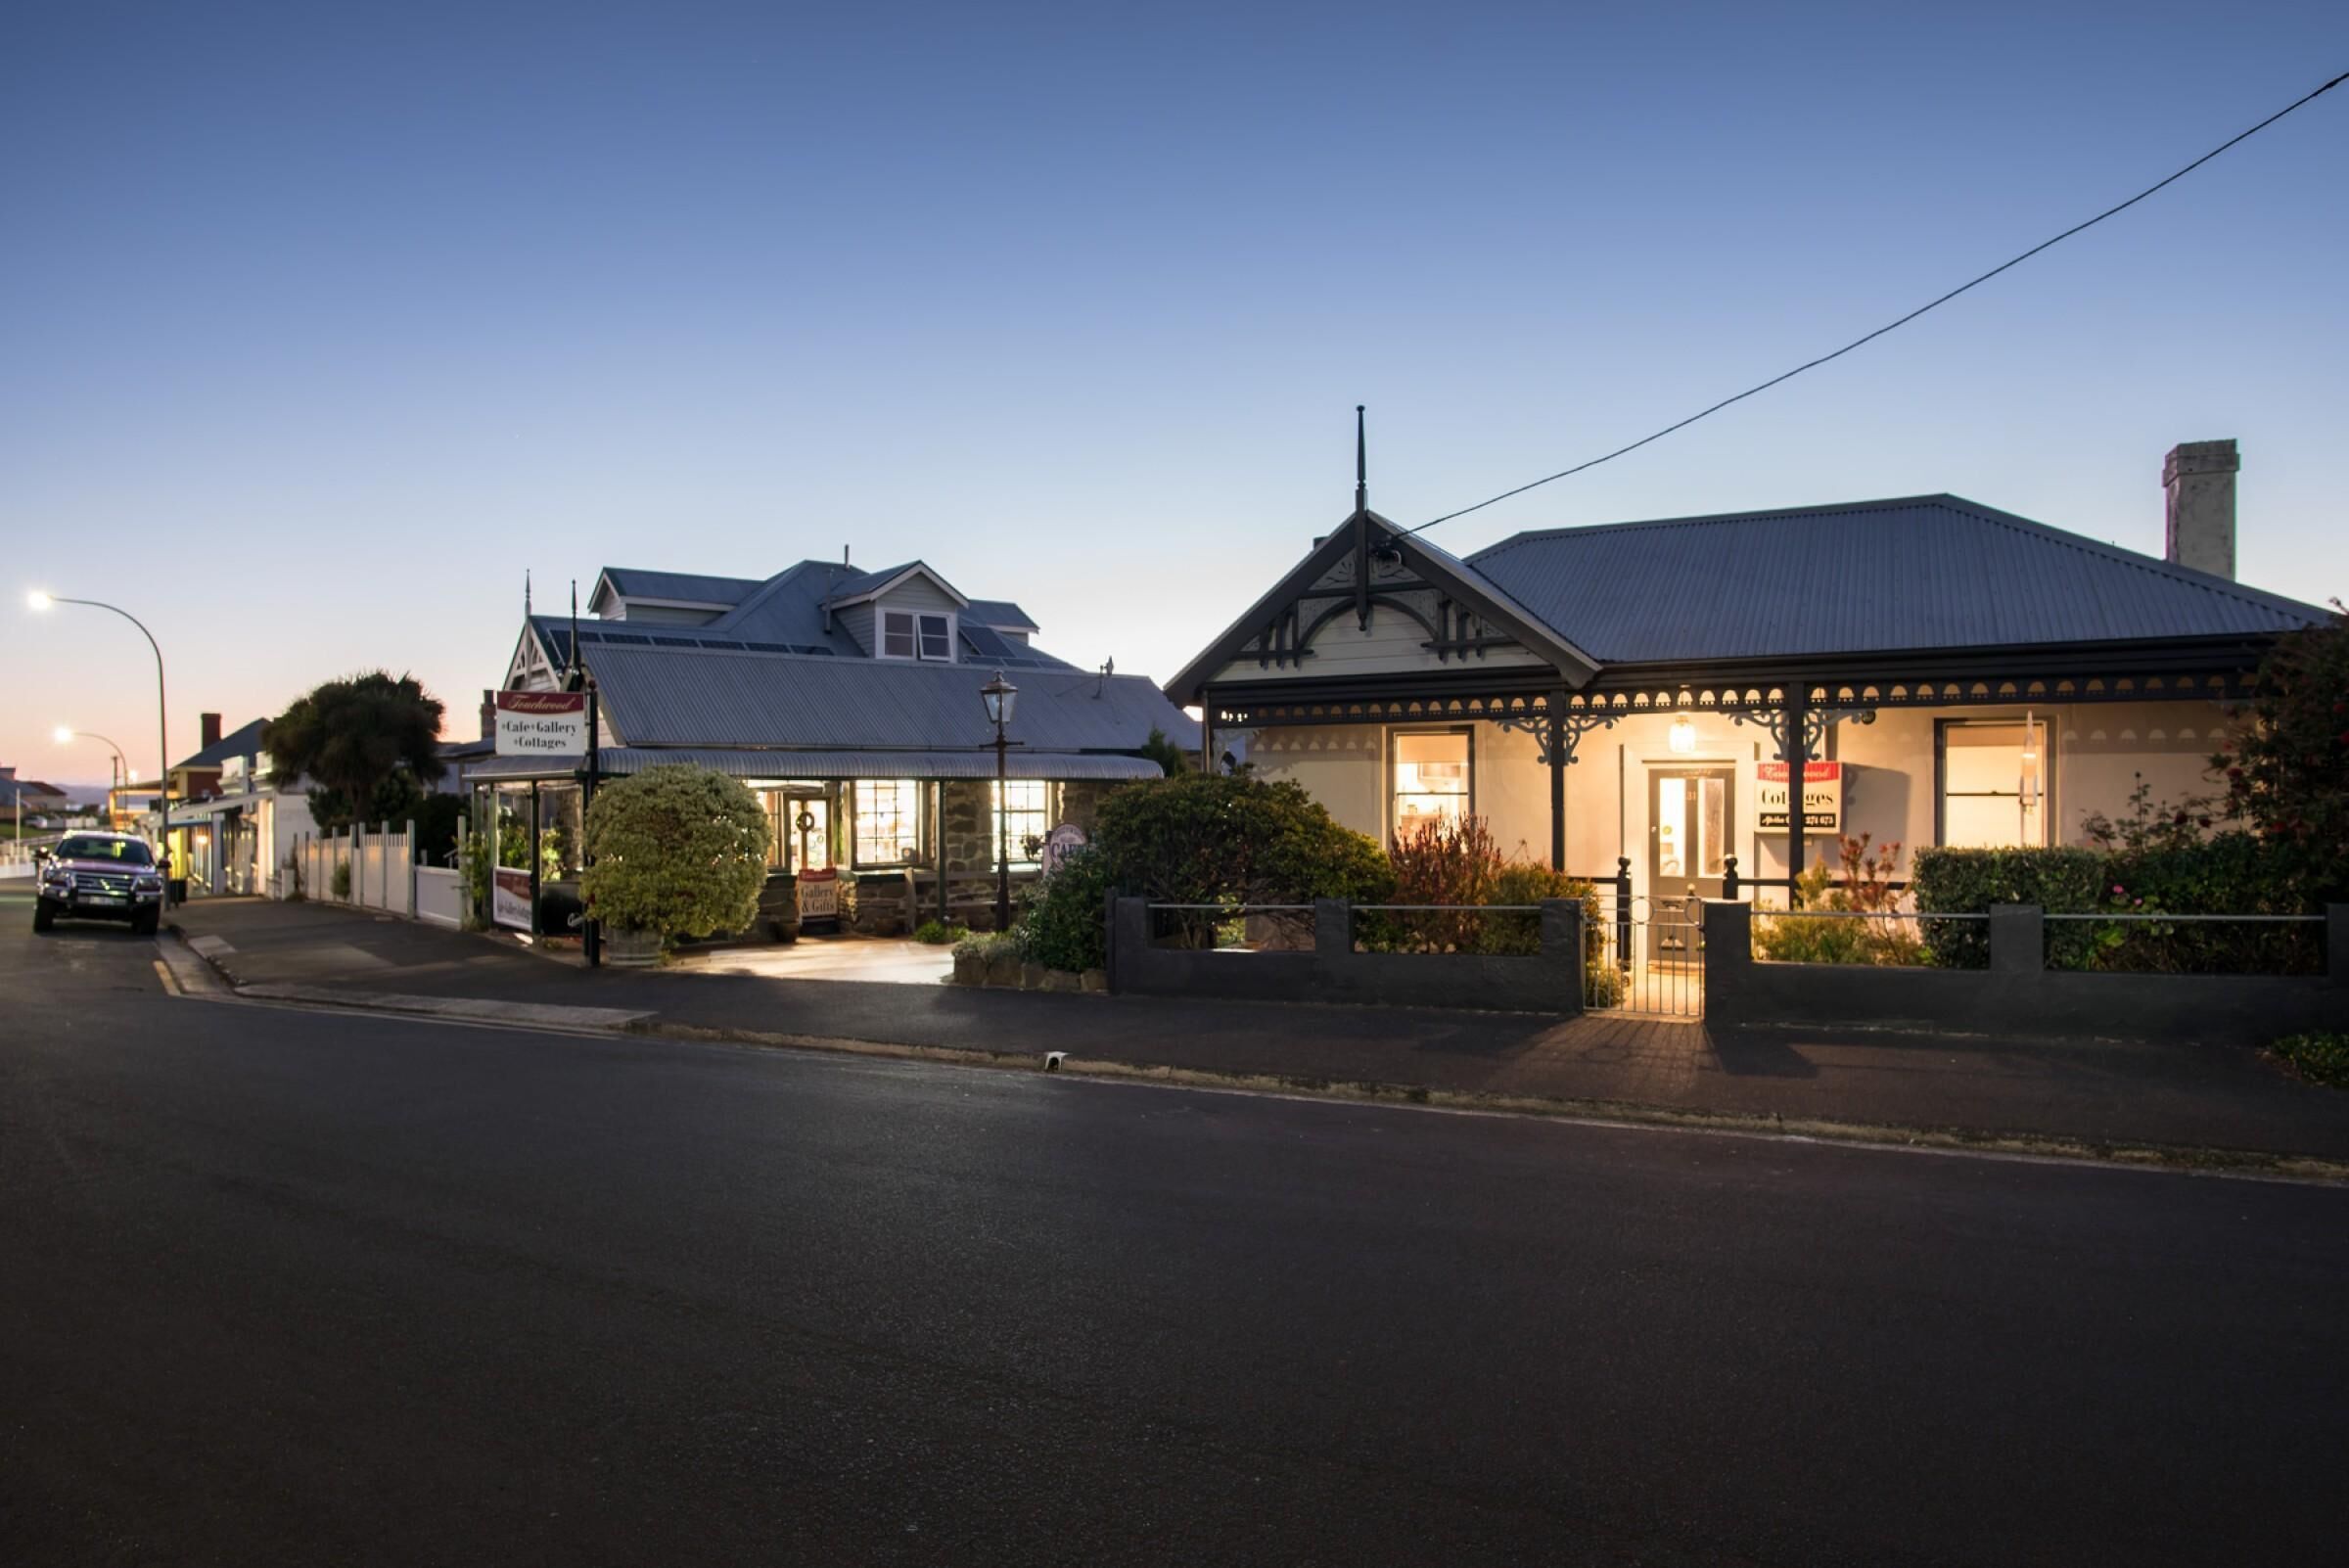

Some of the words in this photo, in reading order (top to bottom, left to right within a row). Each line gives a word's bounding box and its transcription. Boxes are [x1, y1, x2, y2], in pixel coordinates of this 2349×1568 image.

[508, 694, 576, 711] Touchwood
[519, 736, 567, 750] Cottages
[1762, 788, 1833, 809] Cotges
[801, 885, 834, 900] Gallery
[802, 900, 808, 913] &
[812, 899, 834, 912] Gifts
